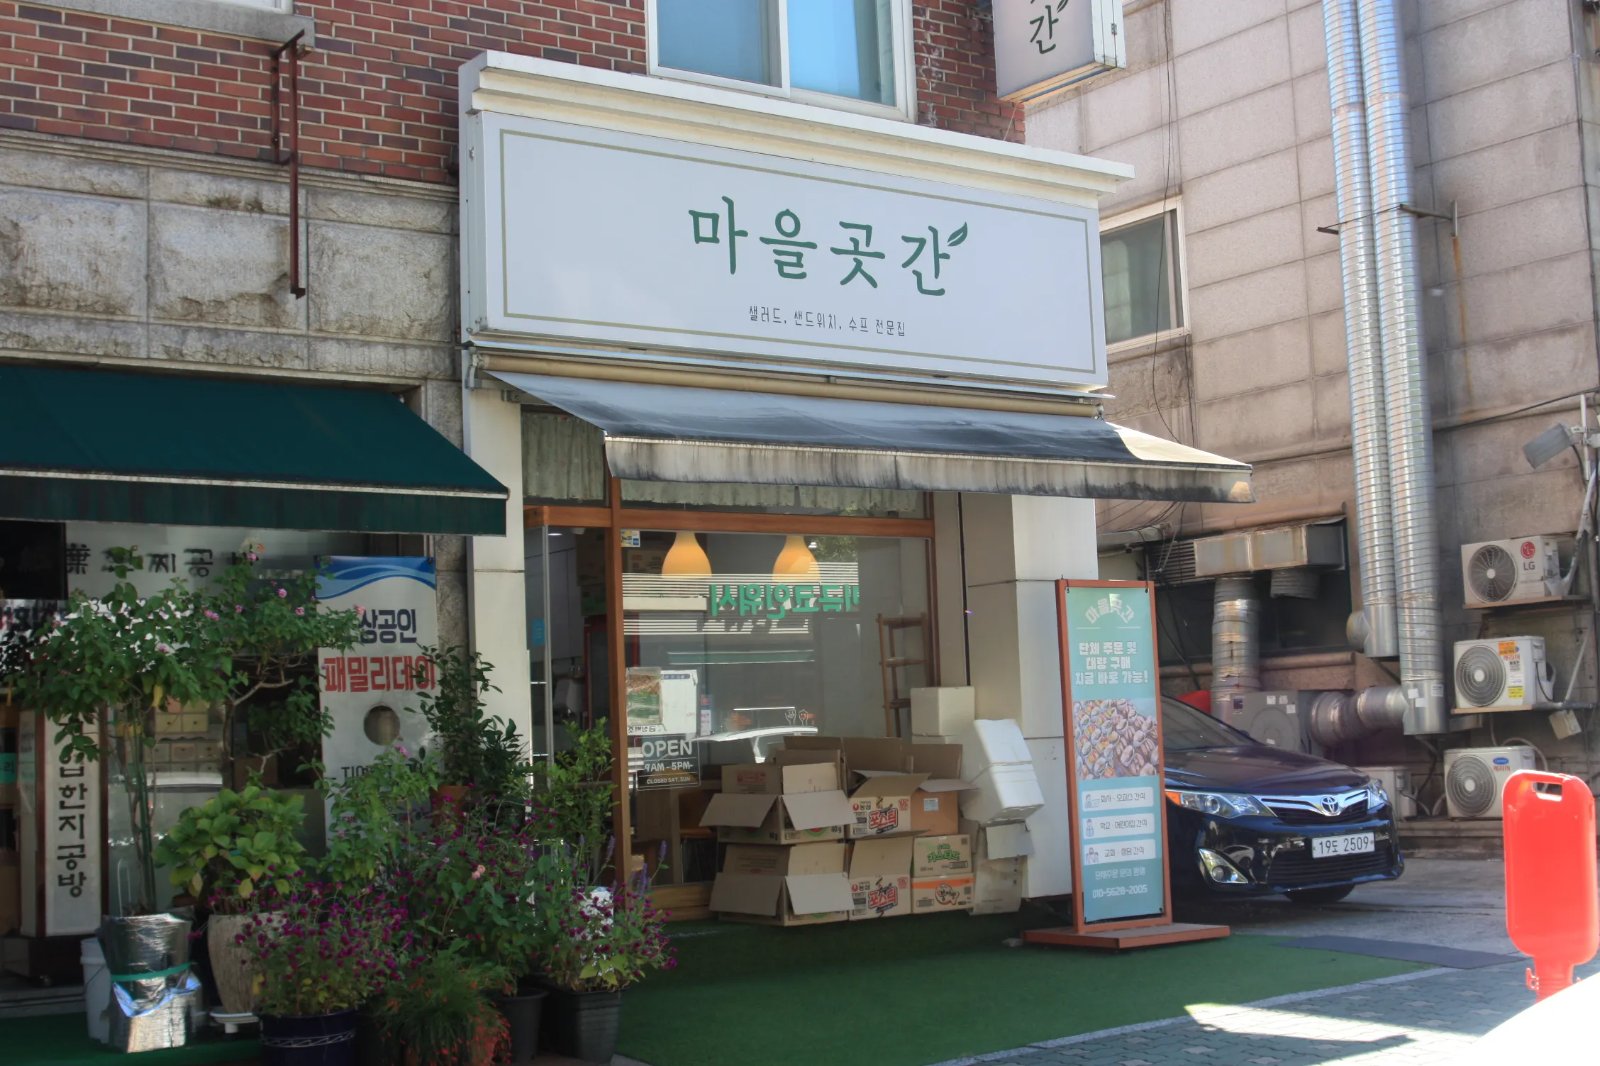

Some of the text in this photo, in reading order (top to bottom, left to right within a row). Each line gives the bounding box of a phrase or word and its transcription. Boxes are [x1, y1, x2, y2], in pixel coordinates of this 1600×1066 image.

[688, 195, 951, 296] 마을곳간
[749, 305, 906, 337] 샐러드, 샌드위치, 수프 전문집
[1523, 561, 1536, 571] LG
[1079, 640, 1137, 656] 단체 주문 및
[1086, 656, 1131, 670] 대량 구매
[324, 655, 437, 692] 패밀리데이
[1075, 670, 1149, 686] 지금 바로 가능!
[641, 739, 692, 758] OPEN
[644, 762, 665, 773] 9AM
[1318, 835, 1369, 855] 19도 2509
